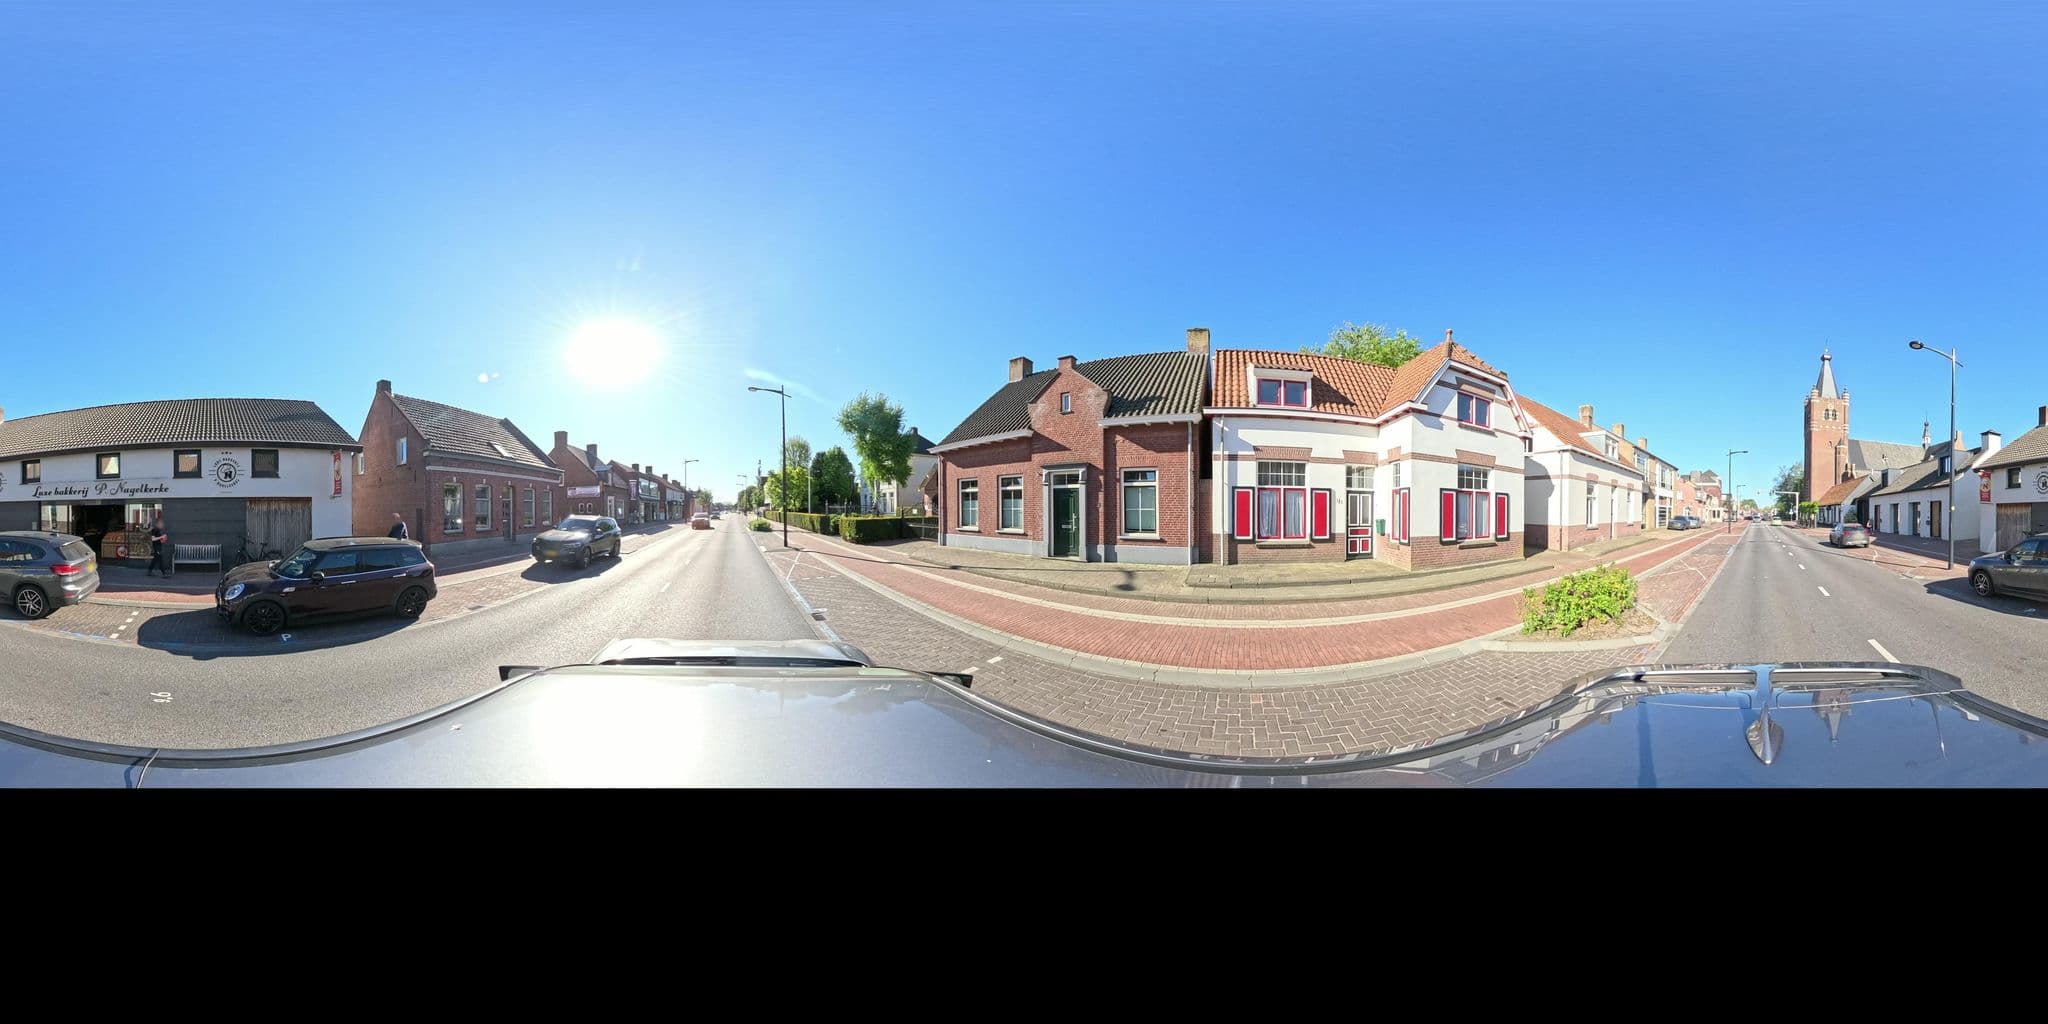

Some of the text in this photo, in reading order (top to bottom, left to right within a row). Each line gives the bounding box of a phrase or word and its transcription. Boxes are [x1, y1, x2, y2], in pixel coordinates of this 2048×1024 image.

[54, 486, 89, 497] bakkerij
[94, 481, 108, 495] P.
[110, 481, 169, 496] Nagelkerke
